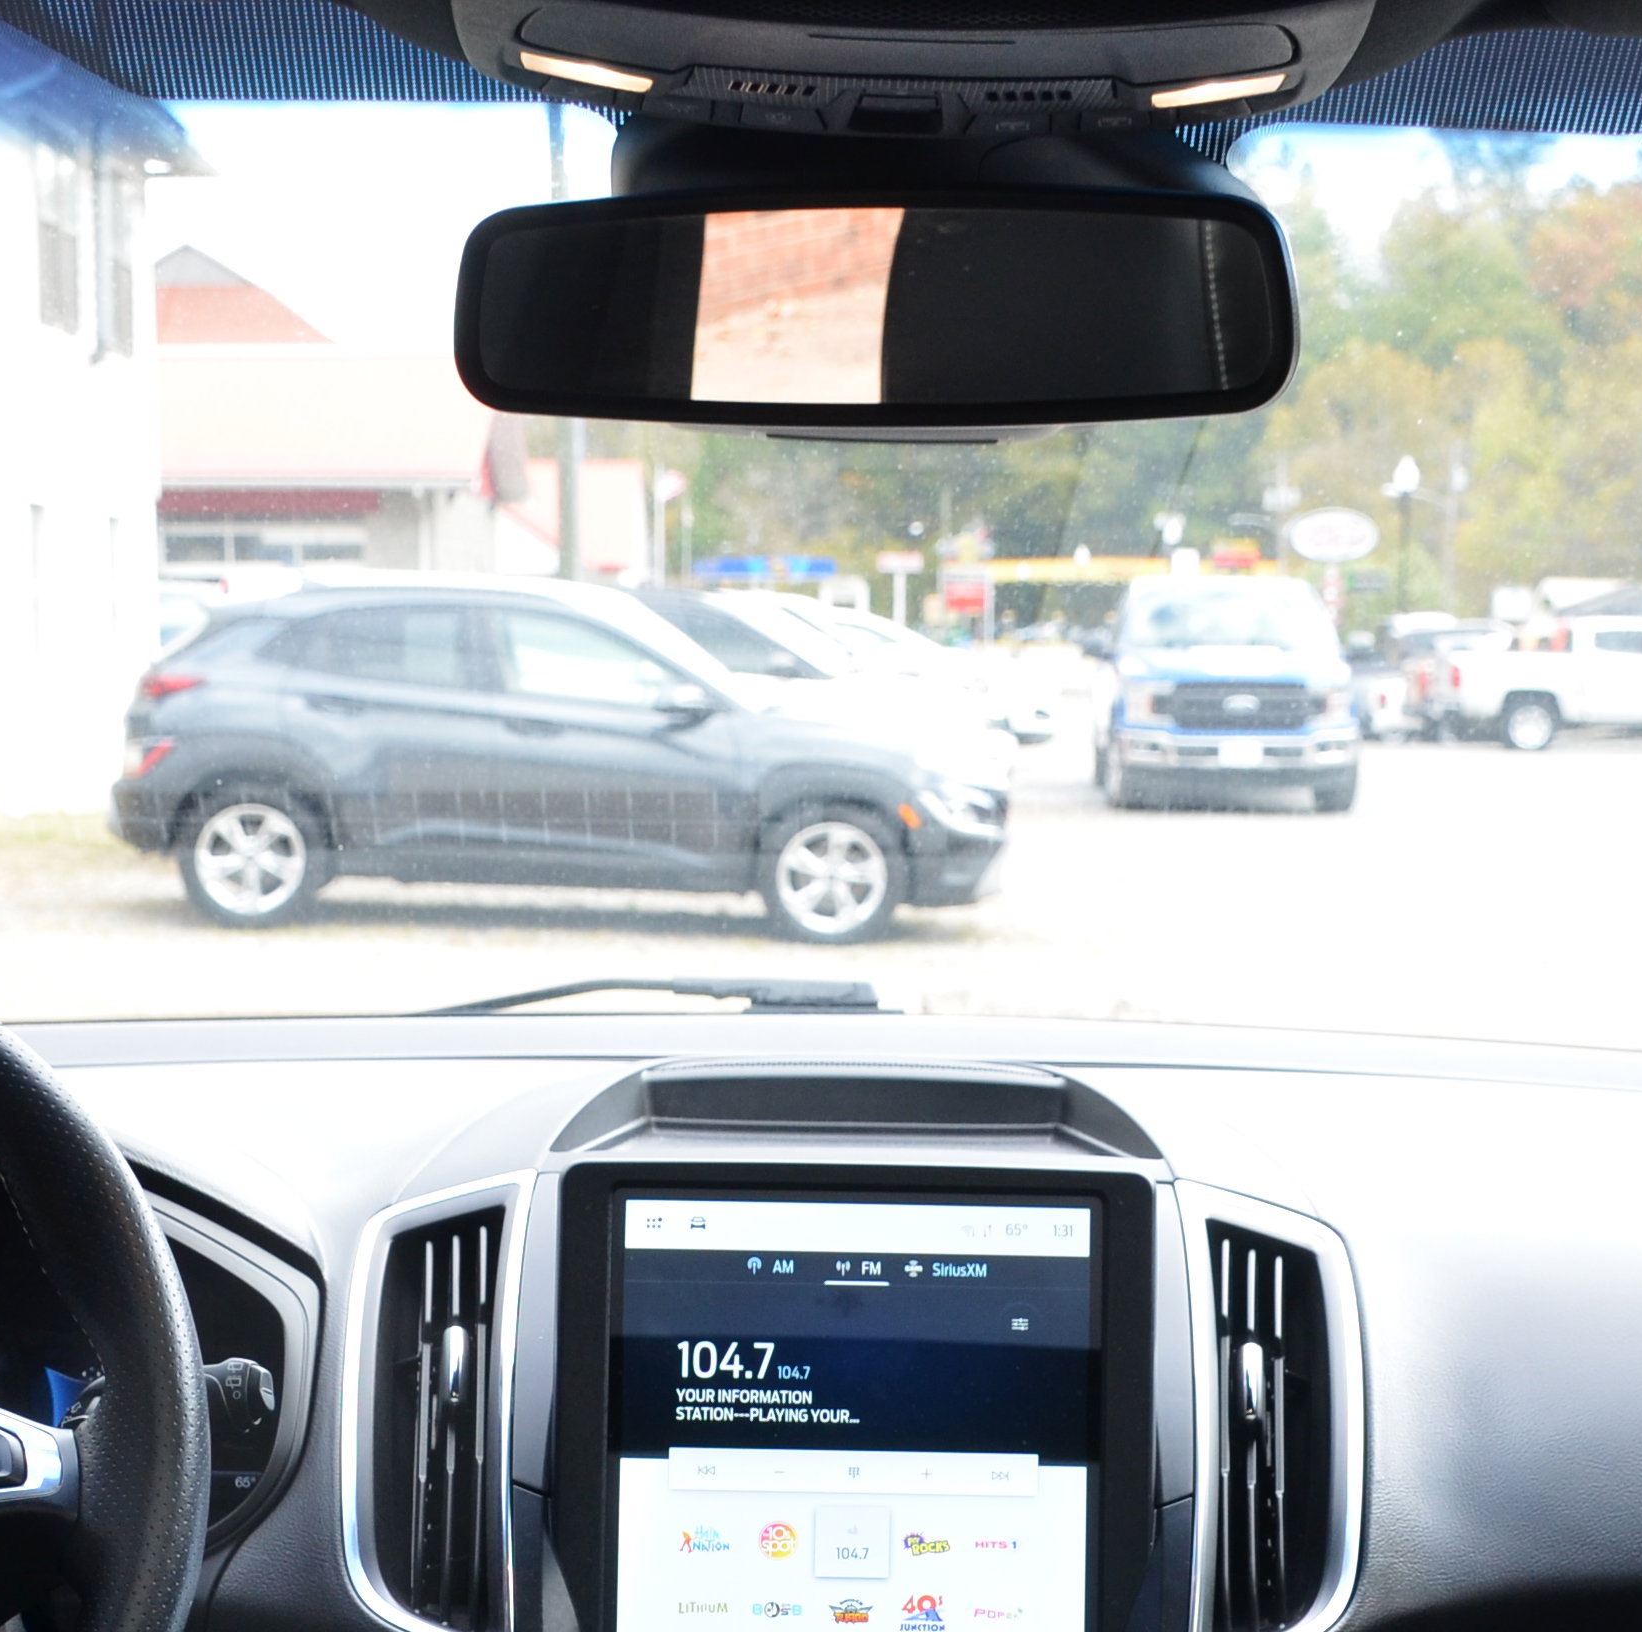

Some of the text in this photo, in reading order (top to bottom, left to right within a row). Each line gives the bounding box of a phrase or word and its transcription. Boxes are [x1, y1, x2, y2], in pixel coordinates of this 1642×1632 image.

[772, 1259, 794, 1274] AM
[861, 1261, 882, 1276] FM
[932, 1262, 988, 1278] SiriusXM
[675, 1340, 811, 1381] 104.7 104.7
[675, 1387, 813, 1405] YOUR INFORMATION
[974, 1540, 1008, 1549] HITS
[836, 1546, 869, 1561] 104.7
[900, 1623, 946, 1632] JUNCTION
